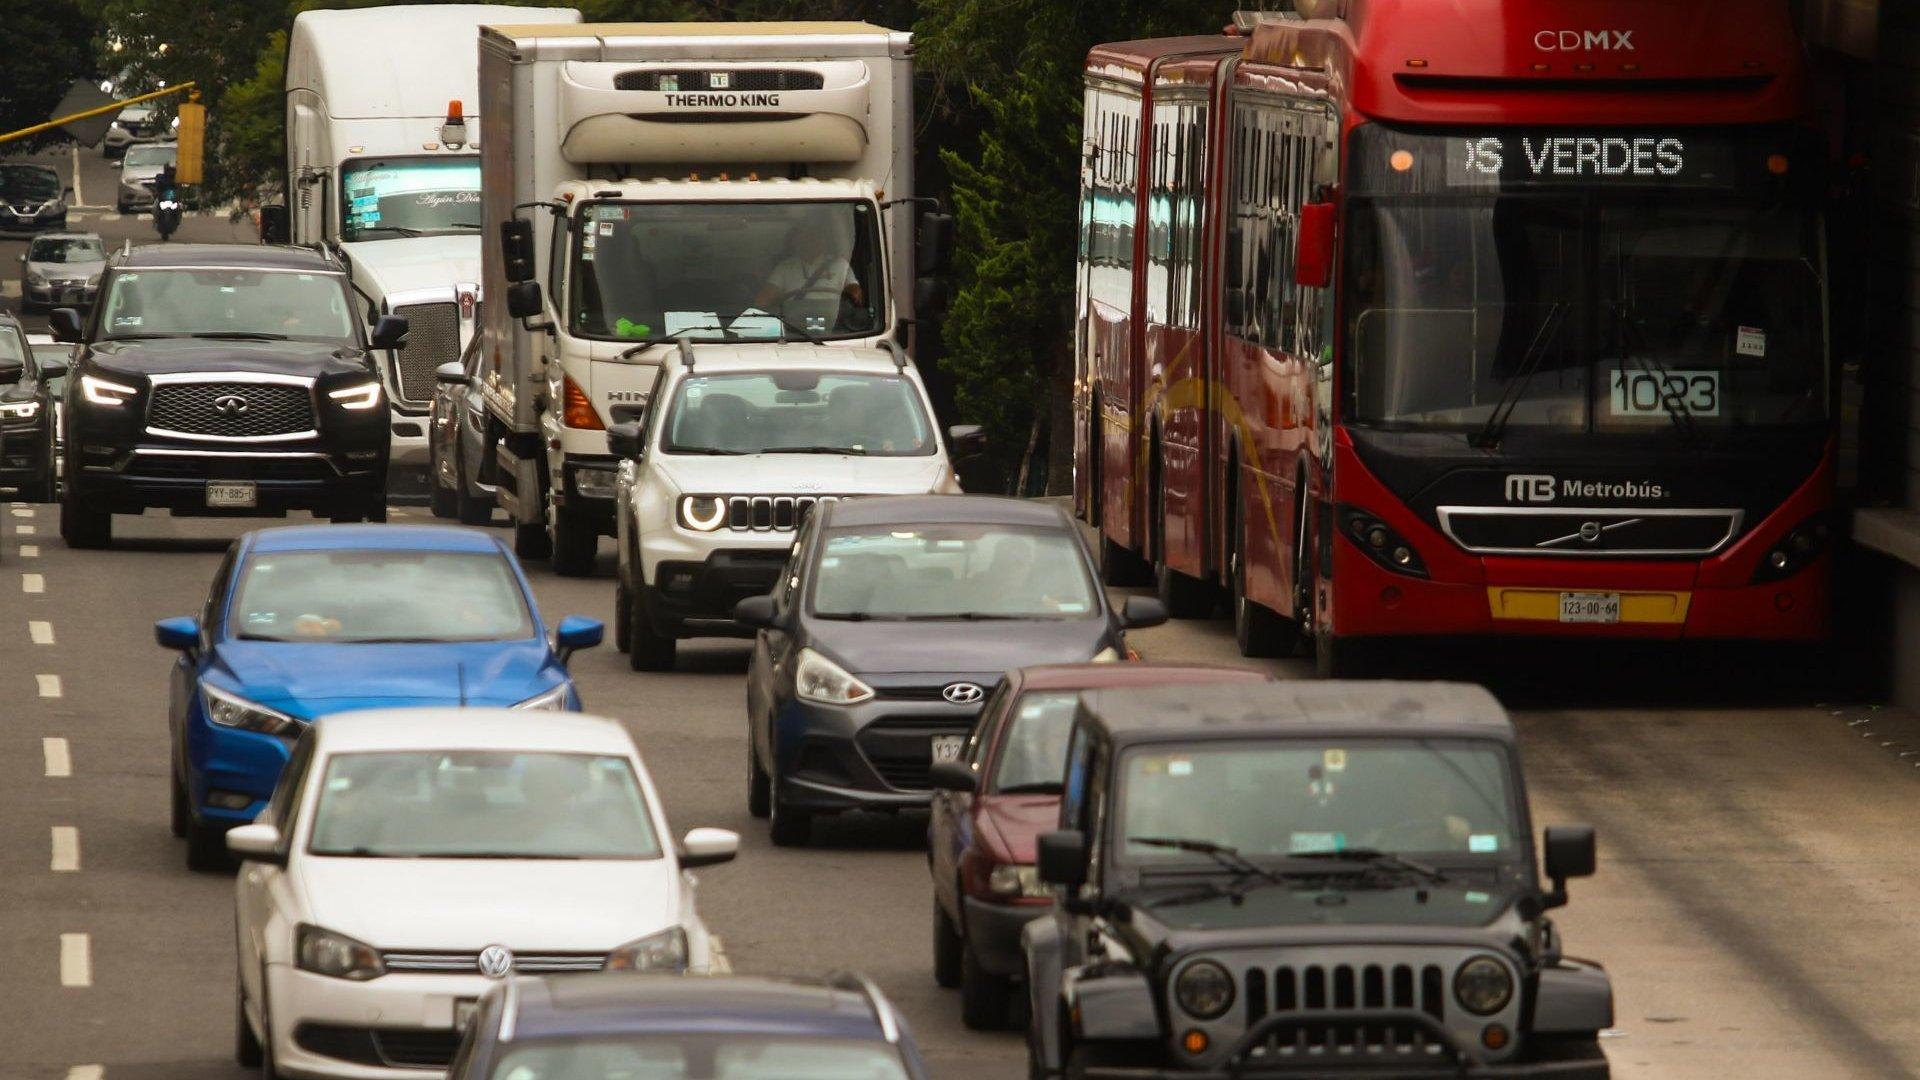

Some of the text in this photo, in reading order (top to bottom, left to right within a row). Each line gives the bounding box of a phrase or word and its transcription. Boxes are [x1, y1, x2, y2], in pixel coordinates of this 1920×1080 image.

[1534, 30, 1635, 51] CDMX
[665, 94, 780, 107] THERMO KING
[1523, 137, 1684, 175] VERDES
[1615, 375, 1716, 412] 1023
[1563, 480, 1663, 498] Metrobús
